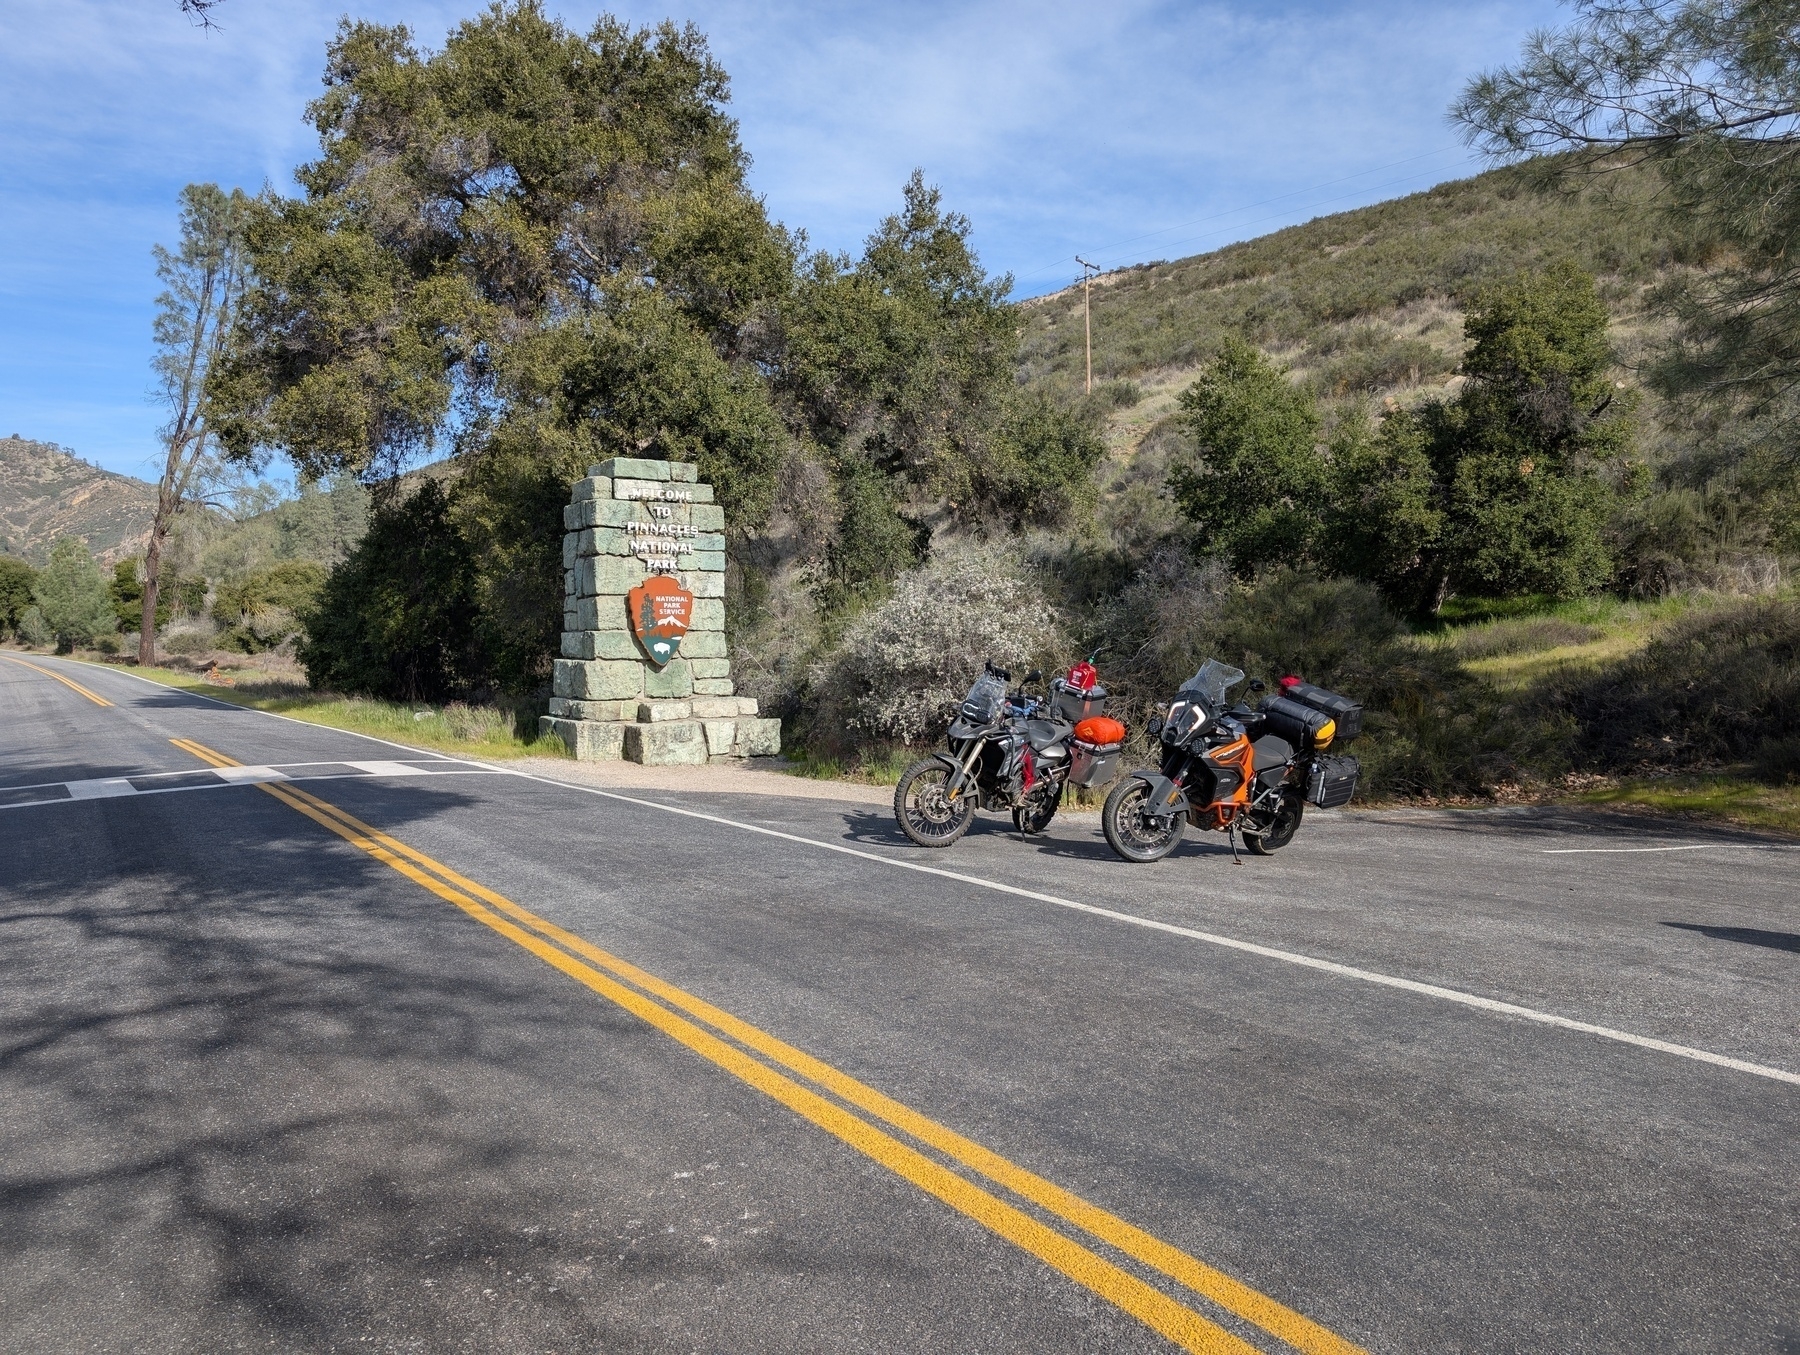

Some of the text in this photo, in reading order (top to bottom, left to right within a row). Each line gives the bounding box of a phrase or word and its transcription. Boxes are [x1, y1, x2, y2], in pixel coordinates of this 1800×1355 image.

[632, 488, 693, 500] WELCOME
[654, 506, 671, 517] TO
[627, 521, 699, 535] PINNACLES
[630, 540, 694, 553] NATIONAL
[647, 558, 678, 569] PARK
